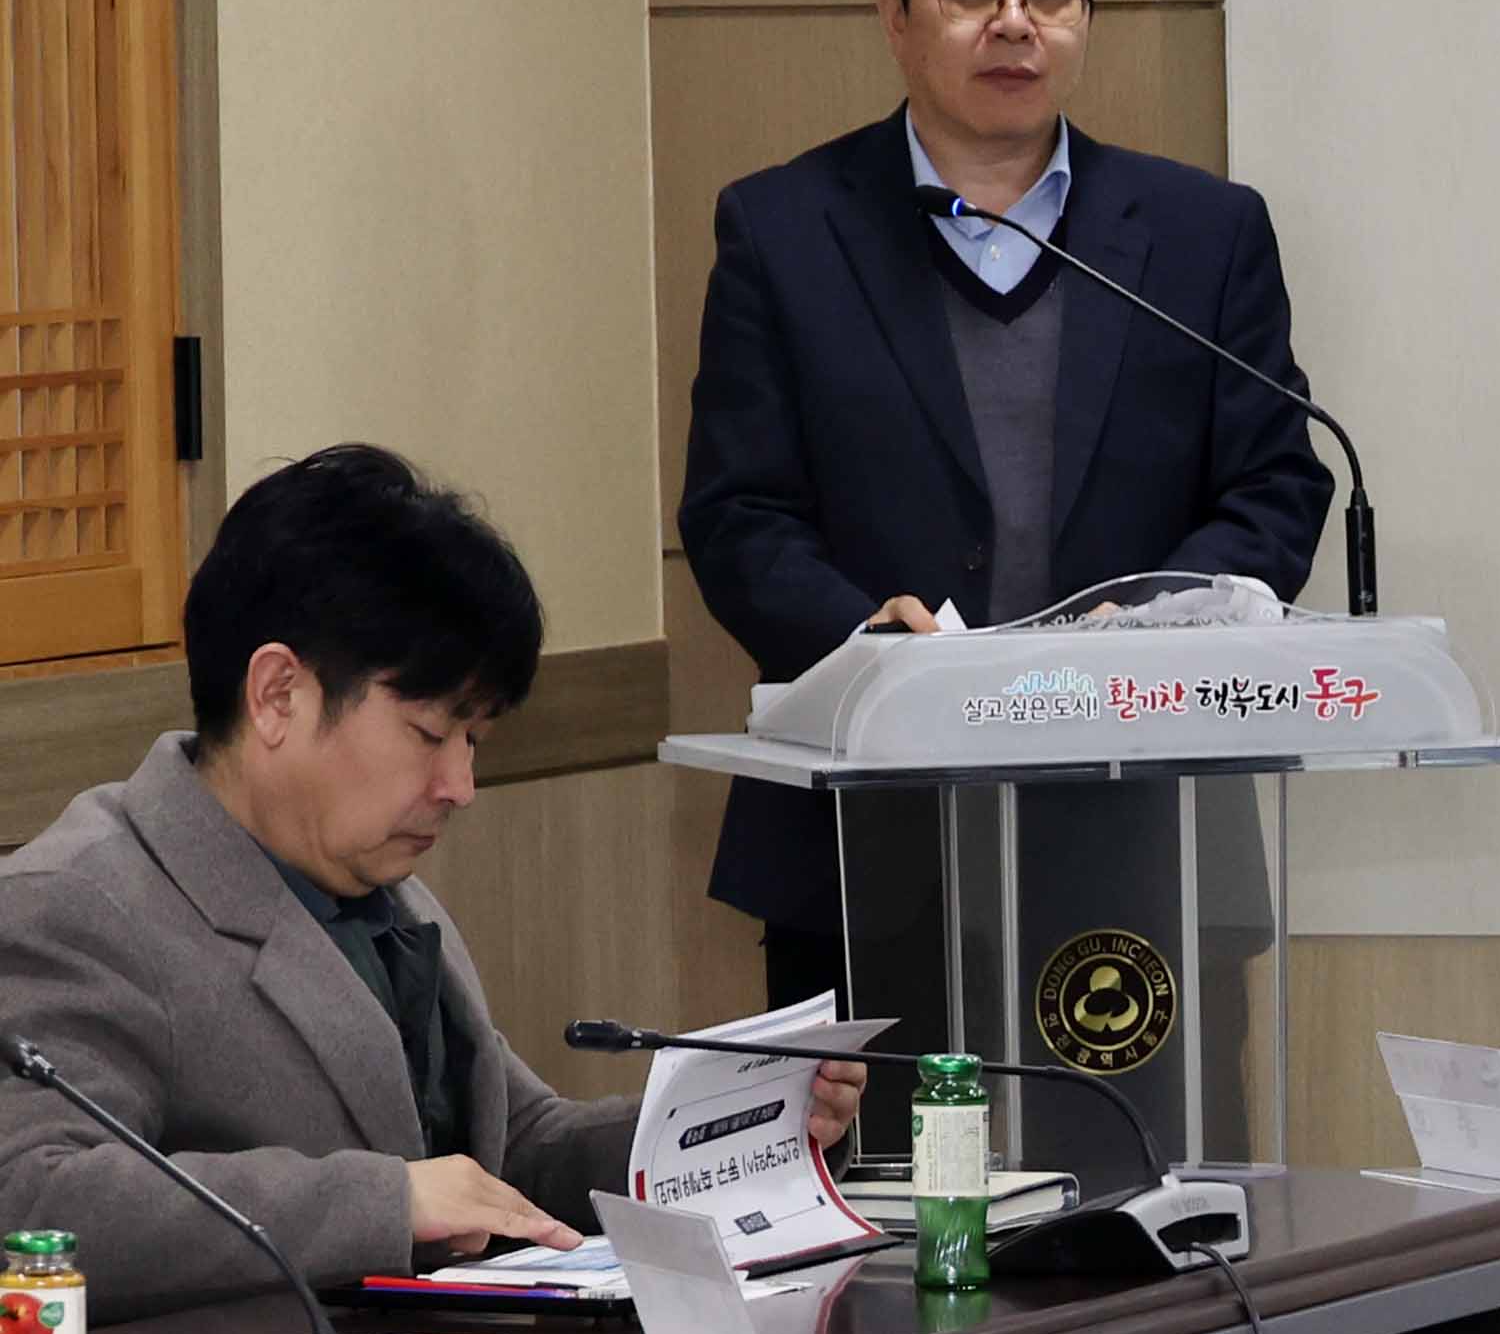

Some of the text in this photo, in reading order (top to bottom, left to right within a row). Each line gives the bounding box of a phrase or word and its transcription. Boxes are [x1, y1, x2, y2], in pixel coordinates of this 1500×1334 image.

[964, 668, 1379, 723] 살고 싶은 도시! 활기찬 행복도시 동구
[1043, 950, 1075, 1000] DONG
